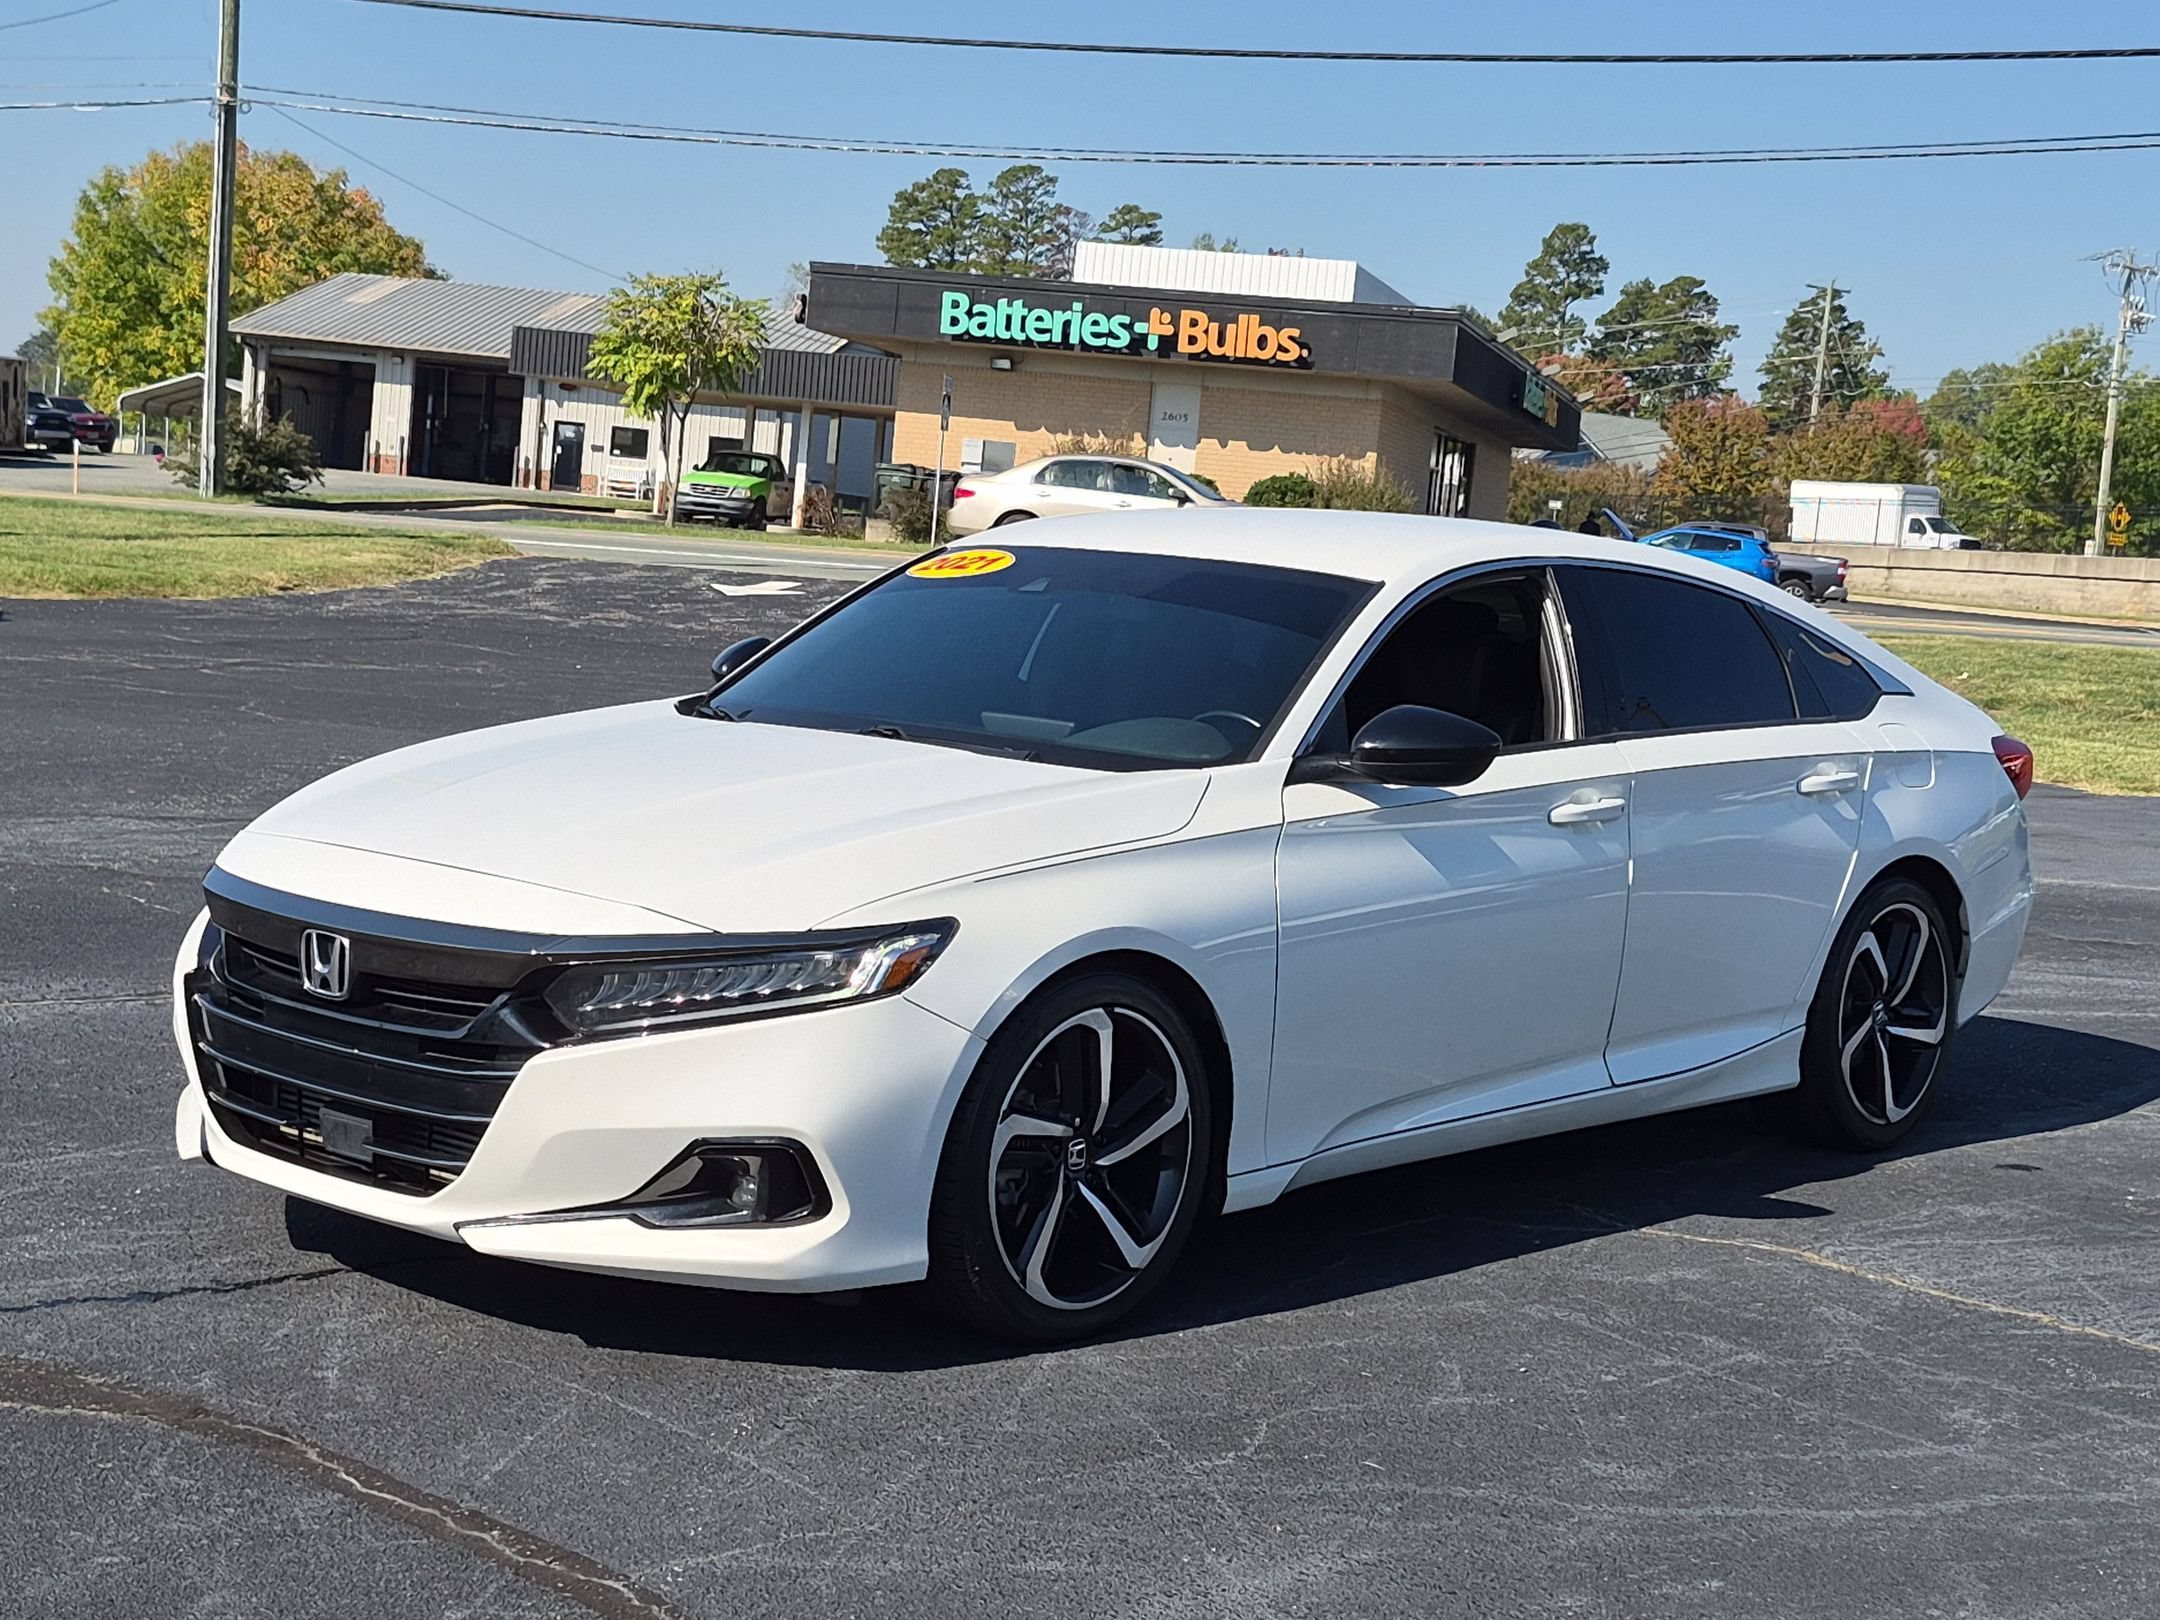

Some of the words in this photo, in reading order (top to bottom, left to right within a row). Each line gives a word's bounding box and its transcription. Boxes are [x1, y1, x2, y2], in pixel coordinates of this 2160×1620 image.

[940, 291, 1130, 348] Batteries
[1161, 411, 1189, 423] 2605
[912, 555, 1007, 571] 2021
